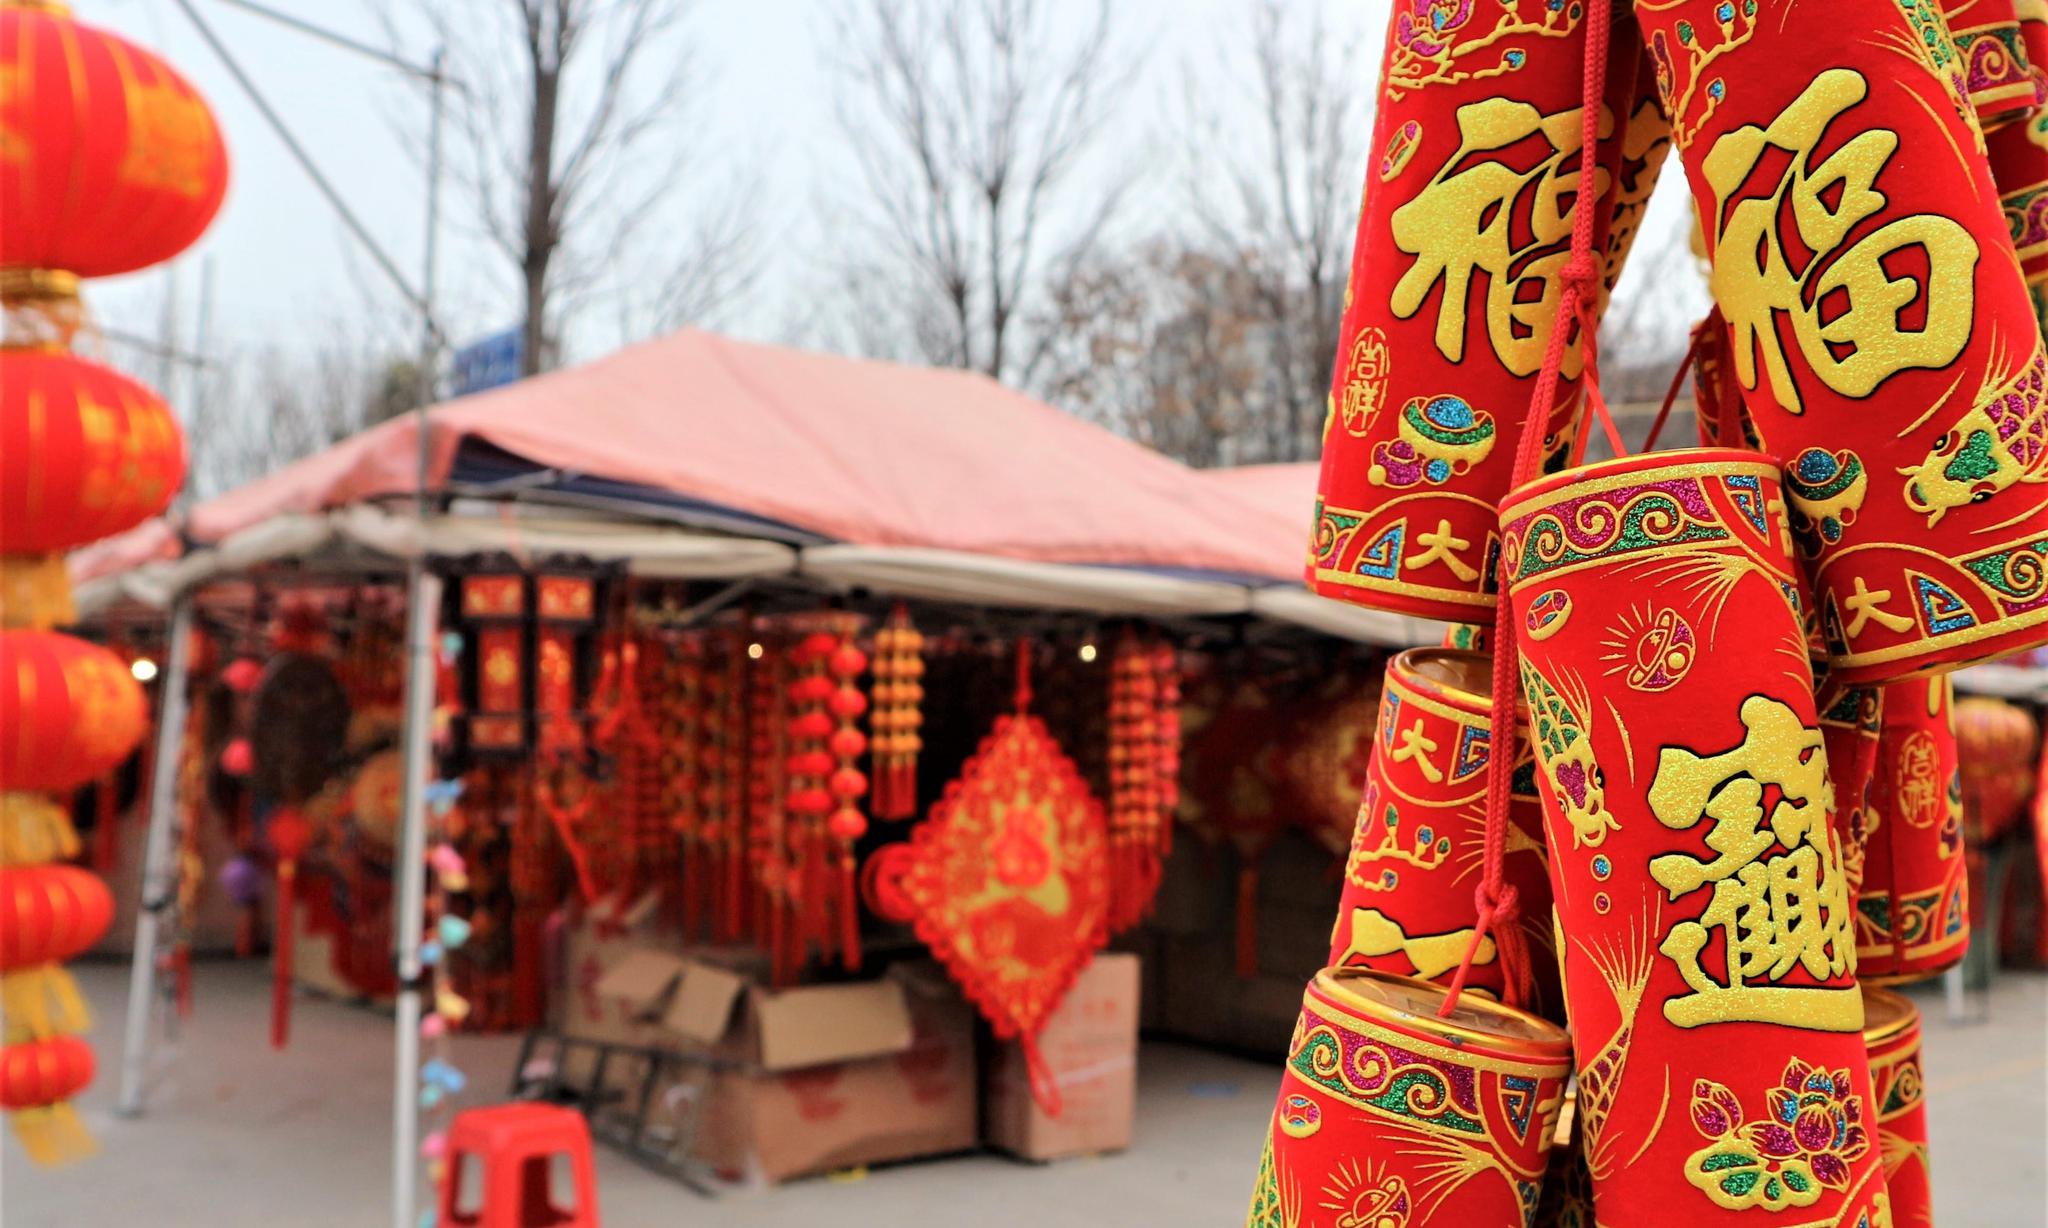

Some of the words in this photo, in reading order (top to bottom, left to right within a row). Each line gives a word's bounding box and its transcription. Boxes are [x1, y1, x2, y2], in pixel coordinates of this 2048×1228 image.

[1391, 97, 1615, 378] 福
[1701, 67, 1980, 416] 福
[1404, 519, 1479, 582] 大
[1846, 576, 1914, 638] 大
[1392, 719, 1443, 783] 大
